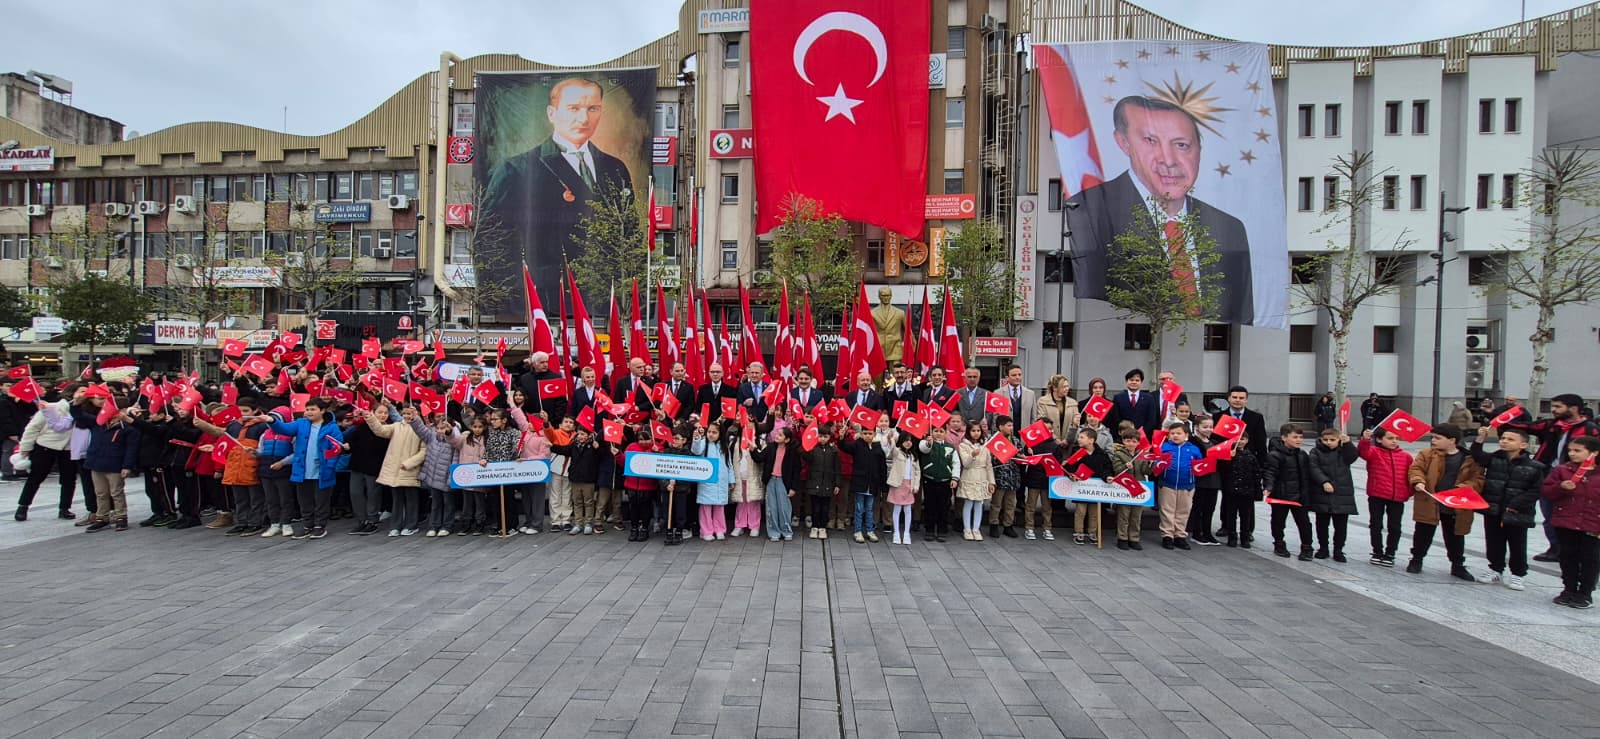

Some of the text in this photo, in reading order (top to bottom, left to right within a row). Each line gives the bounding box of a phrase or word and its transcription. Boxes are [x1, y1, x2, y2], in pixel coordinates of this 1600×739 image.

[157, 325, 217, 339] DERYA EMAK
[1077, 489, 1109, 497] SAKARYA
